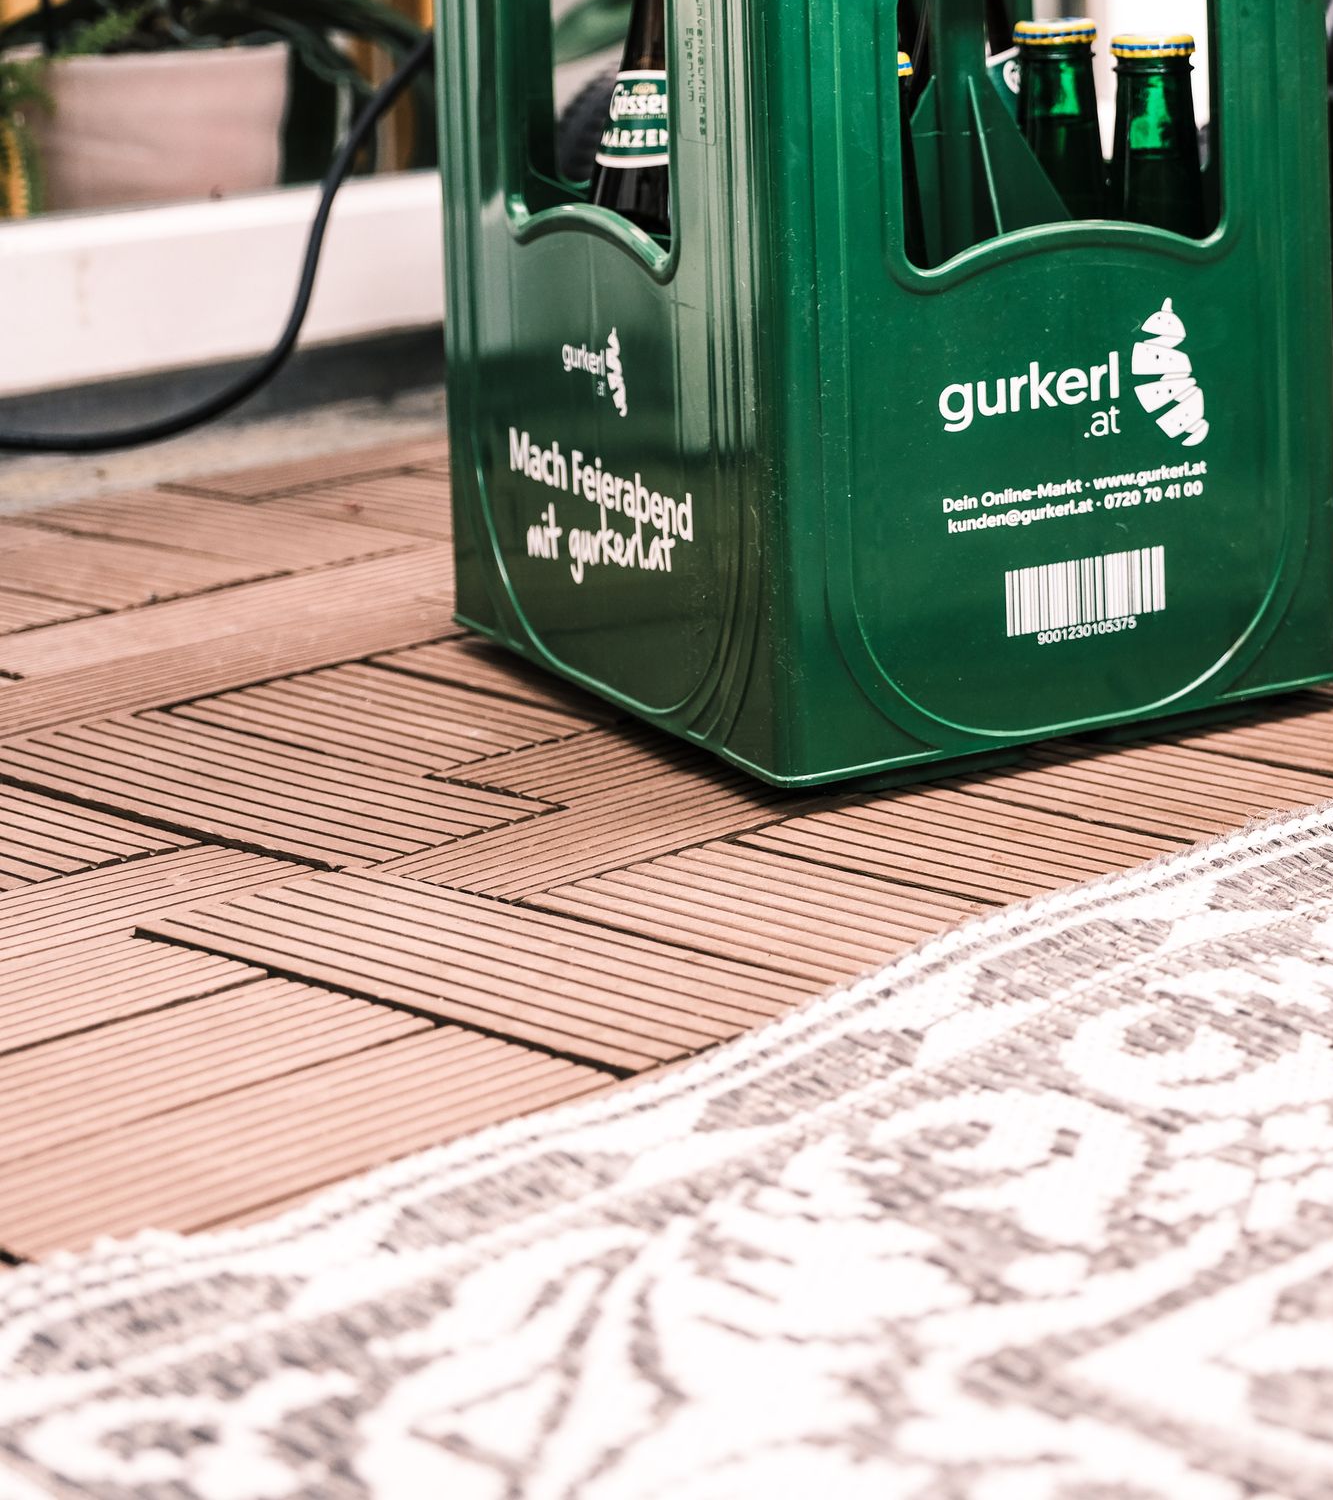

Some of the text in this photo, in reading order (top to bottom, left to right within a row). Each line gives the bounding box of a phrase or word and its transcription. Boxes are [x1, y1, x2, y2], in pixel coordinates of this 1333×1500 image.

[562, 343, 606, 377] gurkerl
[939, 351, 1120, 432] gurkerl
[1083, 406, 1121, 438] .at
[508, 426, 693, 542] Mach Feierabend
[942, 460, 1207, 513] Dein Online-Markt www.gurkerl.at
[947, 480, 1204, 534] kunden@gurkerl.at 0720 70 41 00
[527, 502, 675, 584] mit gurkerl.at
[1037, 616, 1137, 645] 9001230105375
